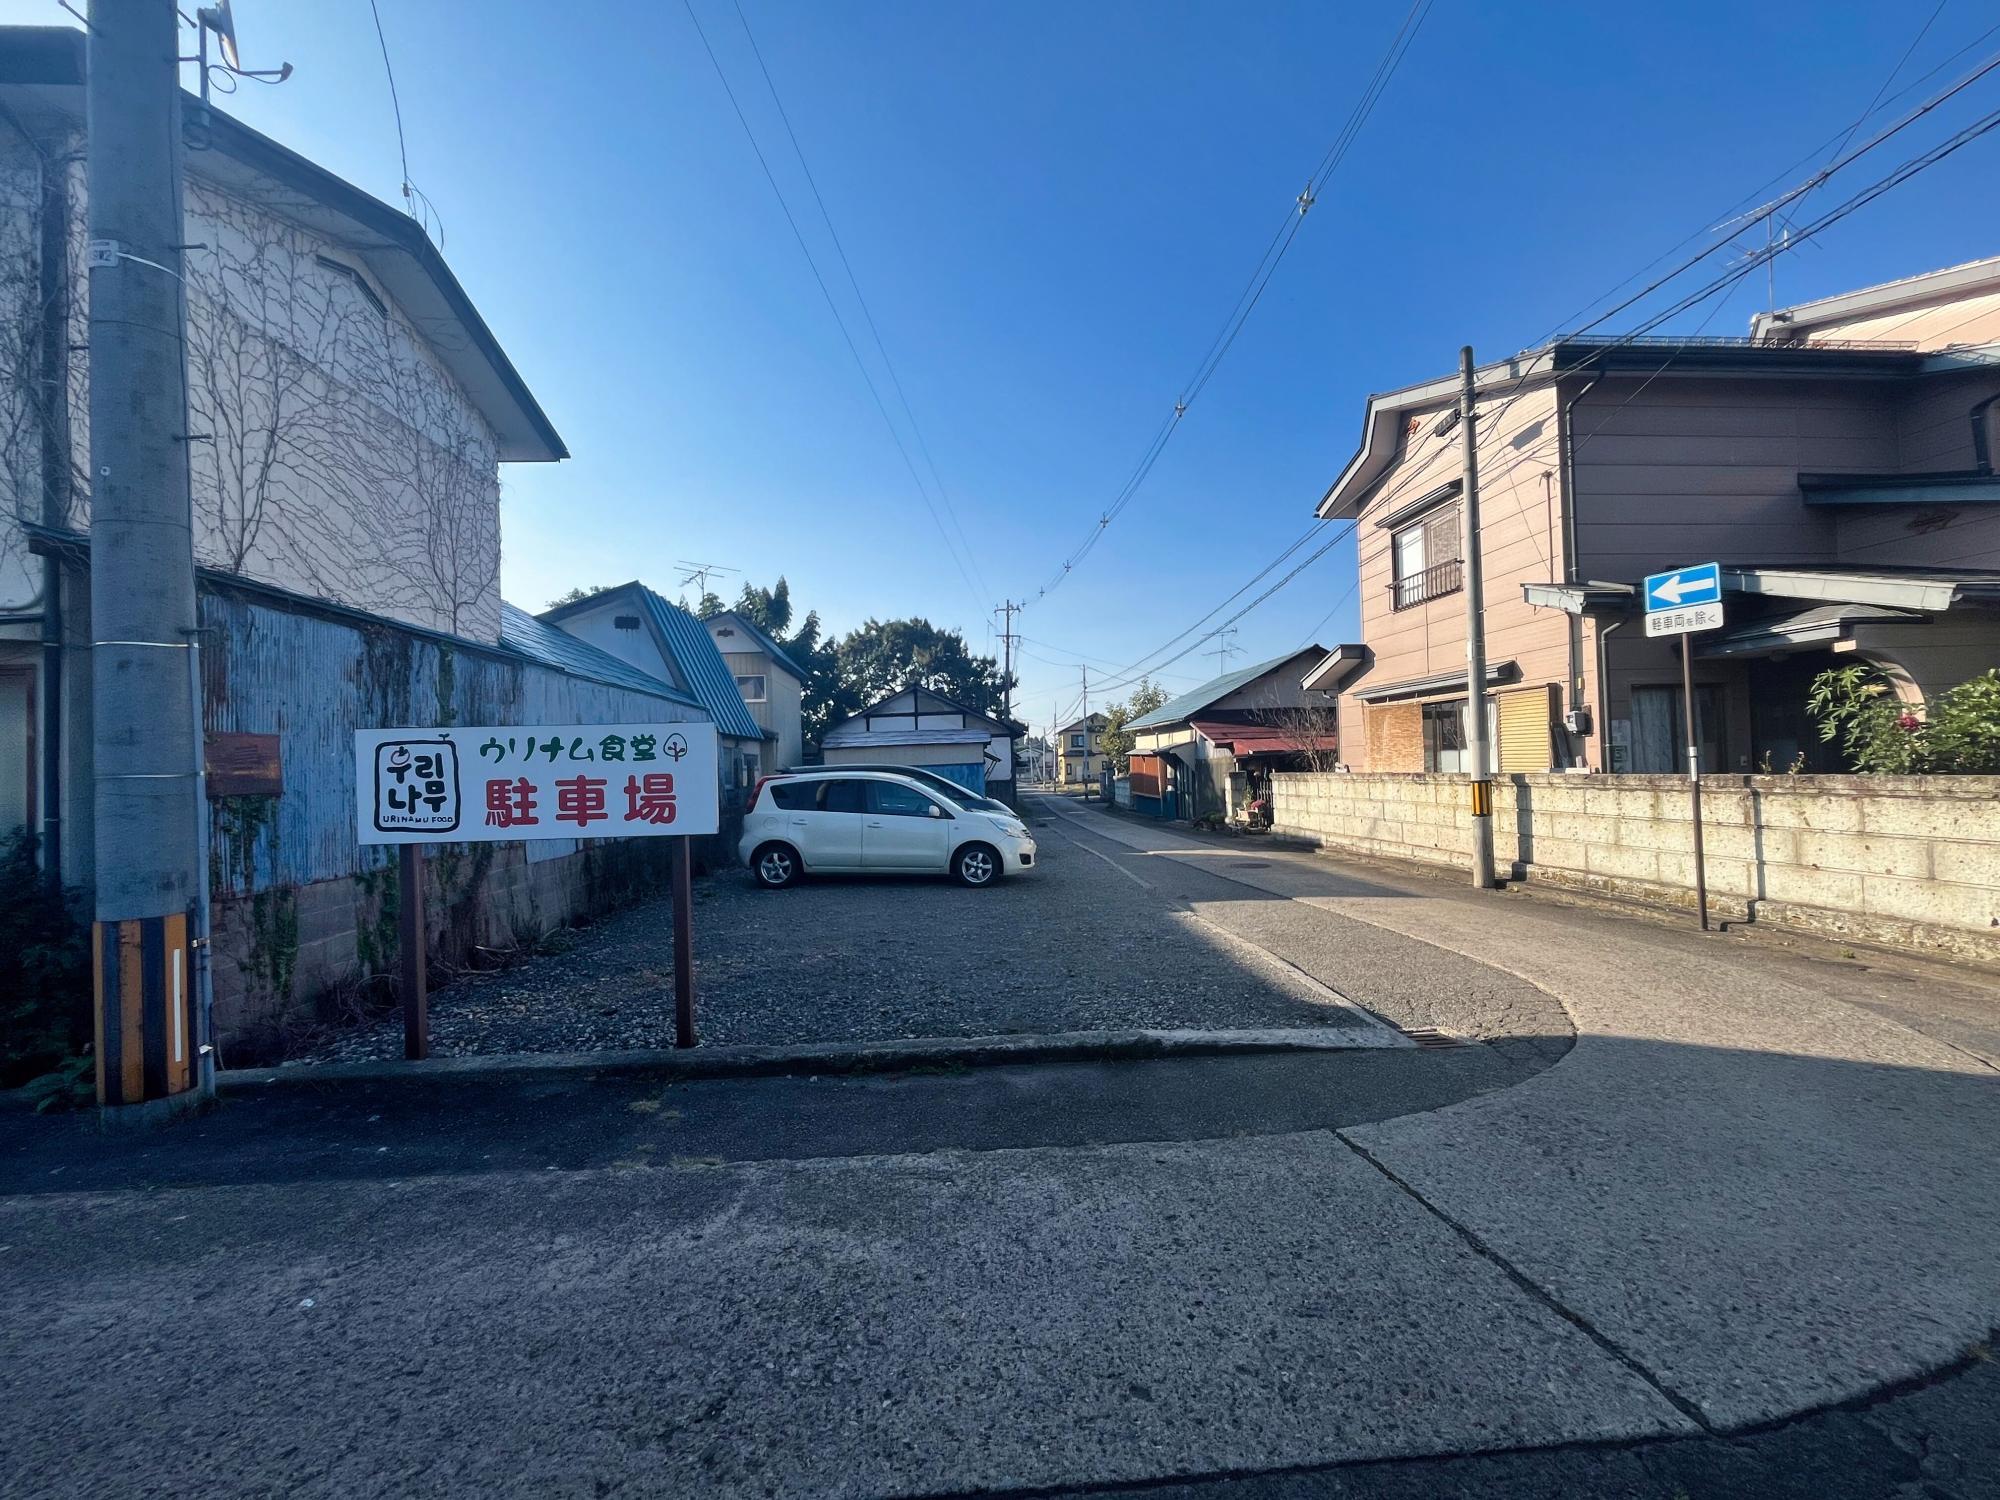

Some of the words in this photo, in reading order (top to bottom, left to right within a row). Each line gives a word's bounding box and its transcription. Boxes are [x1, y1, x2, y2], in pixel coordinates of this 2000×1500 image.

[1652, 611, 1716, 630] 軽車両を除く
[479, 734, 657, 763] ウリナム食堂
[387, 746, 444, 784] 우리
[388, 780, 447, 815] 나무
[485, 773, 677, 828] 駐車場
[383, 815, 429, 823] URINAMU
